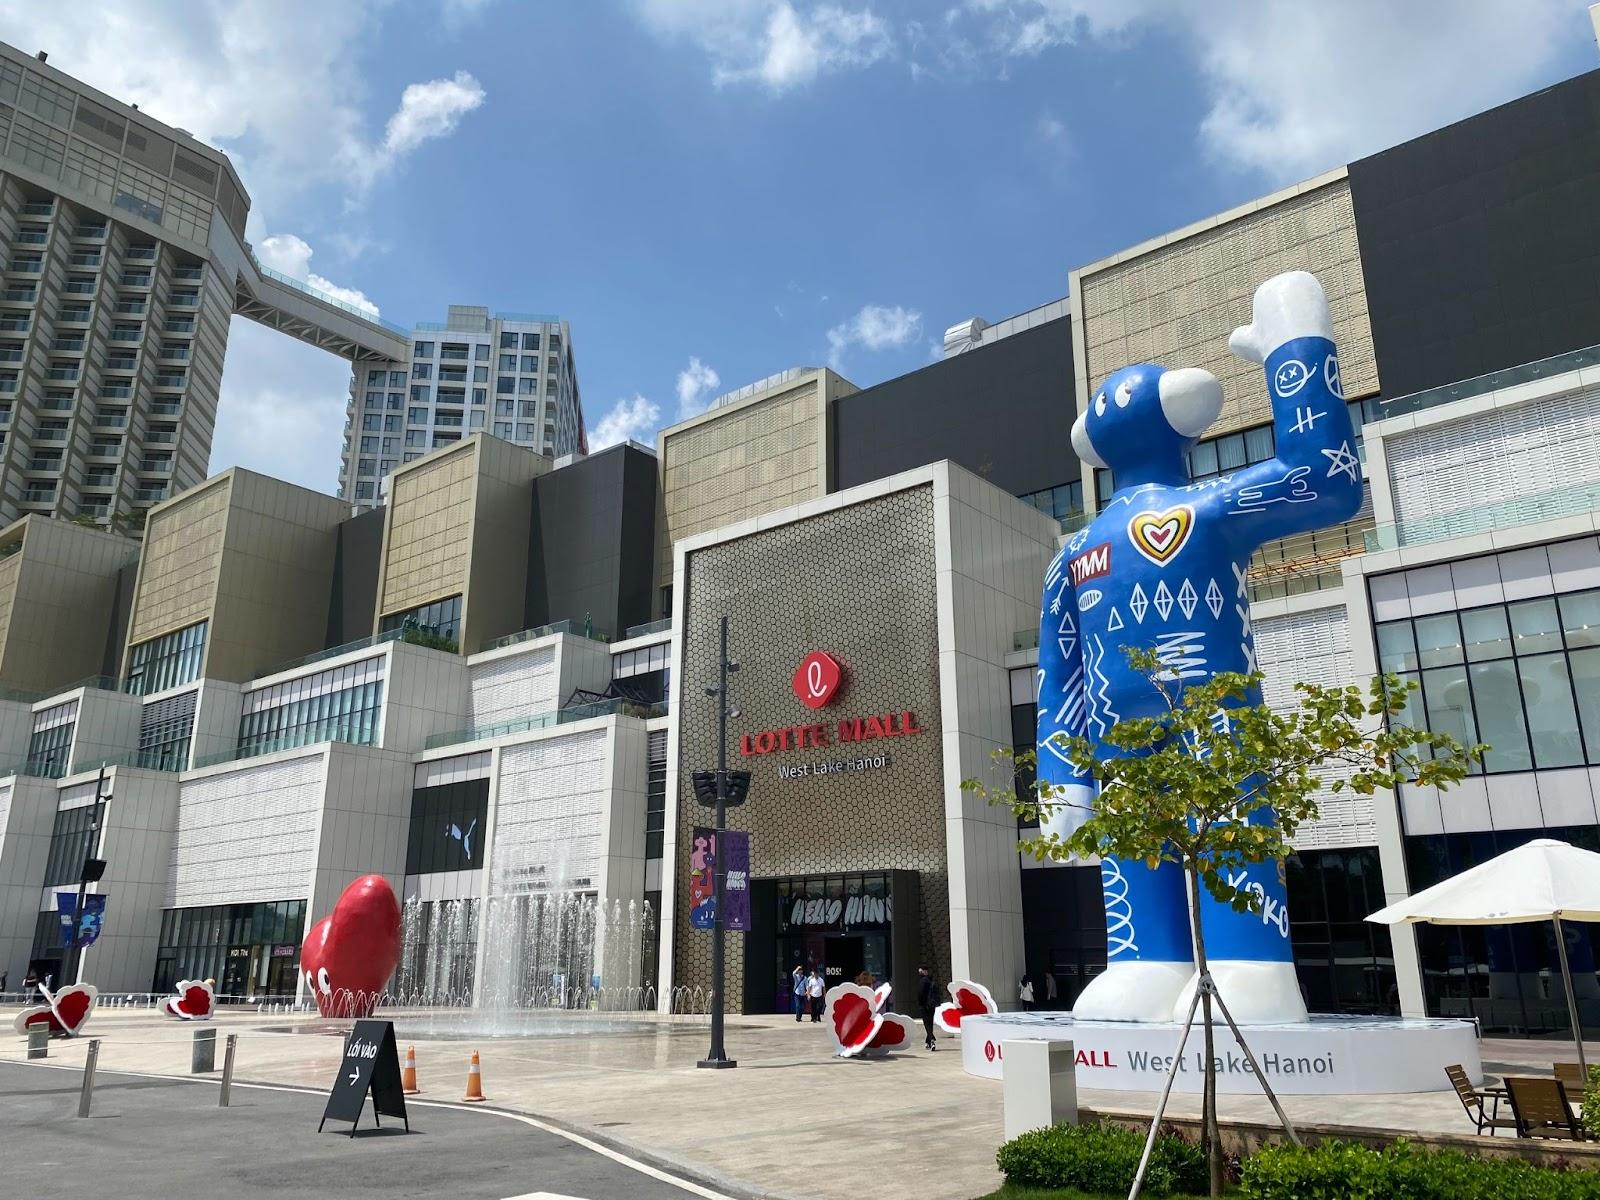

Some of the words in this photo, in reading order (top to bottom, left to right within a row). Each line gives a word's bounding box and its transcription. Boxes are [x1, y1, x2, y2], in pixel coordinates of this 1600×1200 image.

[740, 723, 830, 756] LOTTE
[838, 710, 921, 743] MALL
[778, 762, 808, 779] West
[813, 760, 843, 775] Lake
[847, 753, 886, 771] Hanoi
[790, 898, 842, 926] HELLO
[346, 1037, 362, 1058] LỐI
[360, 1041, 378, 1059] VÀO
[1074, 1049, 1118, 1068] ALL
[1127, 1051, 1187, 1073] West
[1196, 1051, 1255, 1074] Lake
[1263, 1052, 1335, 1074] Hanoi
